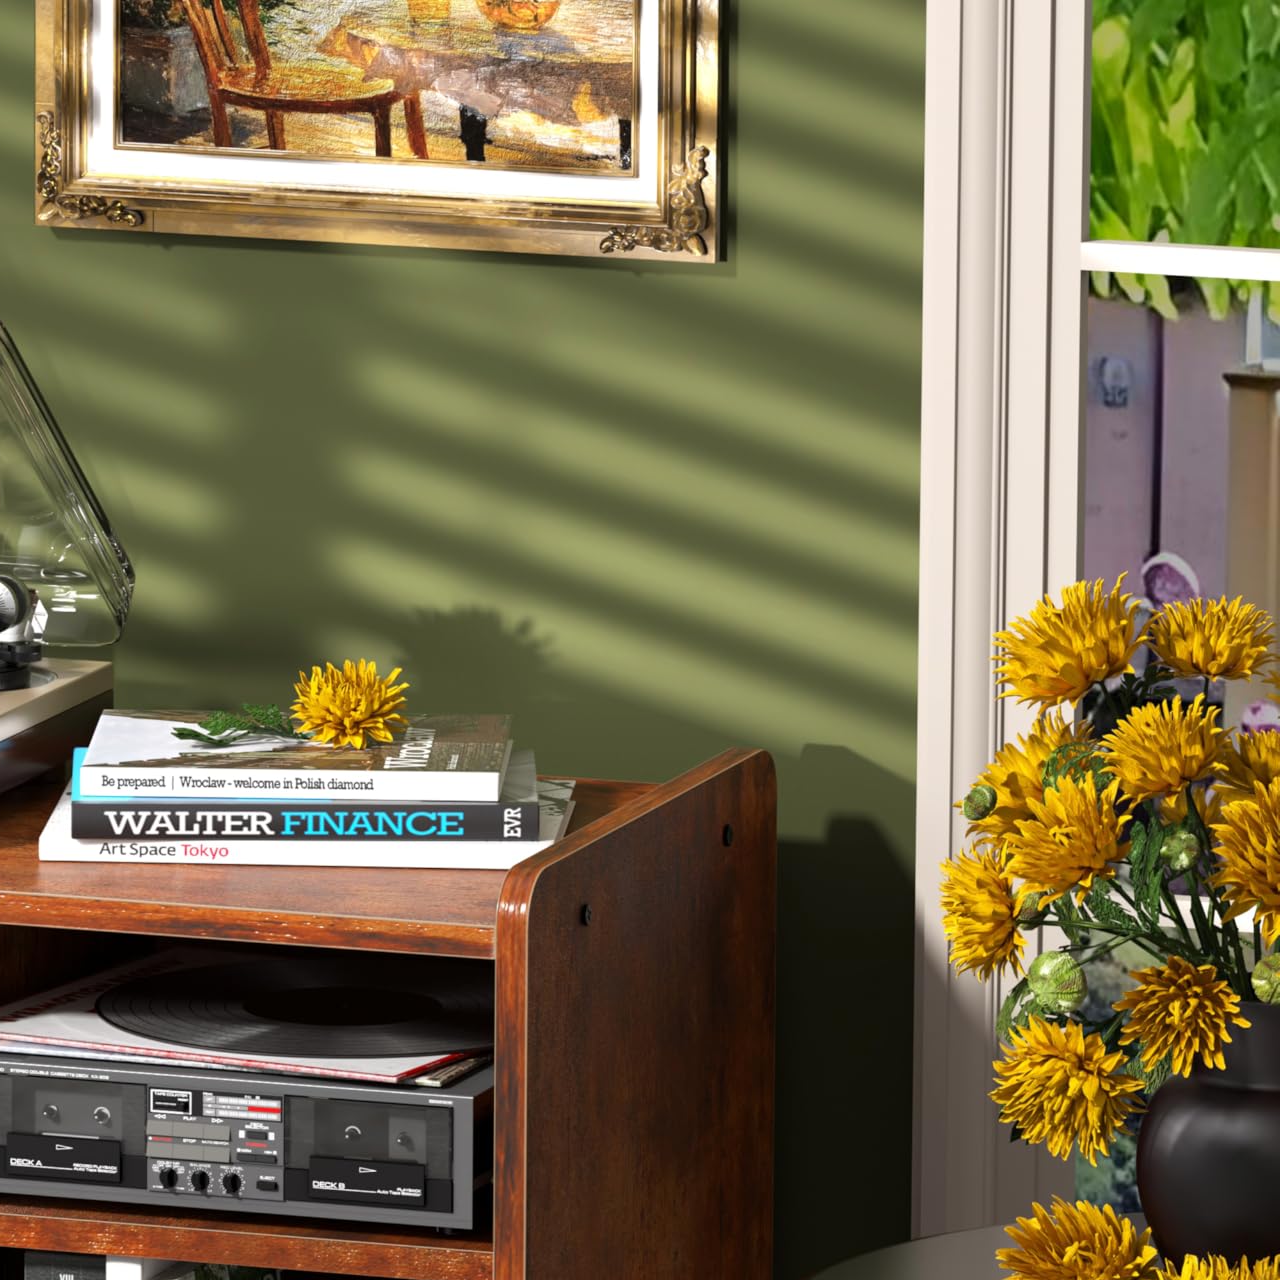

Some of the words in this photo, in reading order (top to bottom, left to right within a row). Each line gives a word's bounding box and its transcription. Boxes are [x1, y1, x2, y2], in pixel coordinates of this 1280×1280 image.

[102, 775, 115, 787] Be
[117, 776, 165, 790] prepared
[179, 776, 226, 788] Wroclaw
[233, 777, 281, 789] welcome
[283, 777, 293, 789] in
[294, 777, 325, 790] Polish
[327, 778, 374, 791] diamond
[104, 810, 275, 836] WALTER
[281, 811, 464, 837] FINANCE
[504, 807, 521, 838] EVR
[99, 842, 127, 857] Art
[129, 842, 177, 859] Space
[181, 843, 230, 861] Tokyo
[10, 1157, 34, 1167] DECK
[312, 1180, 337, 1190] DECK
[338, 1182, 346, 1190] B
